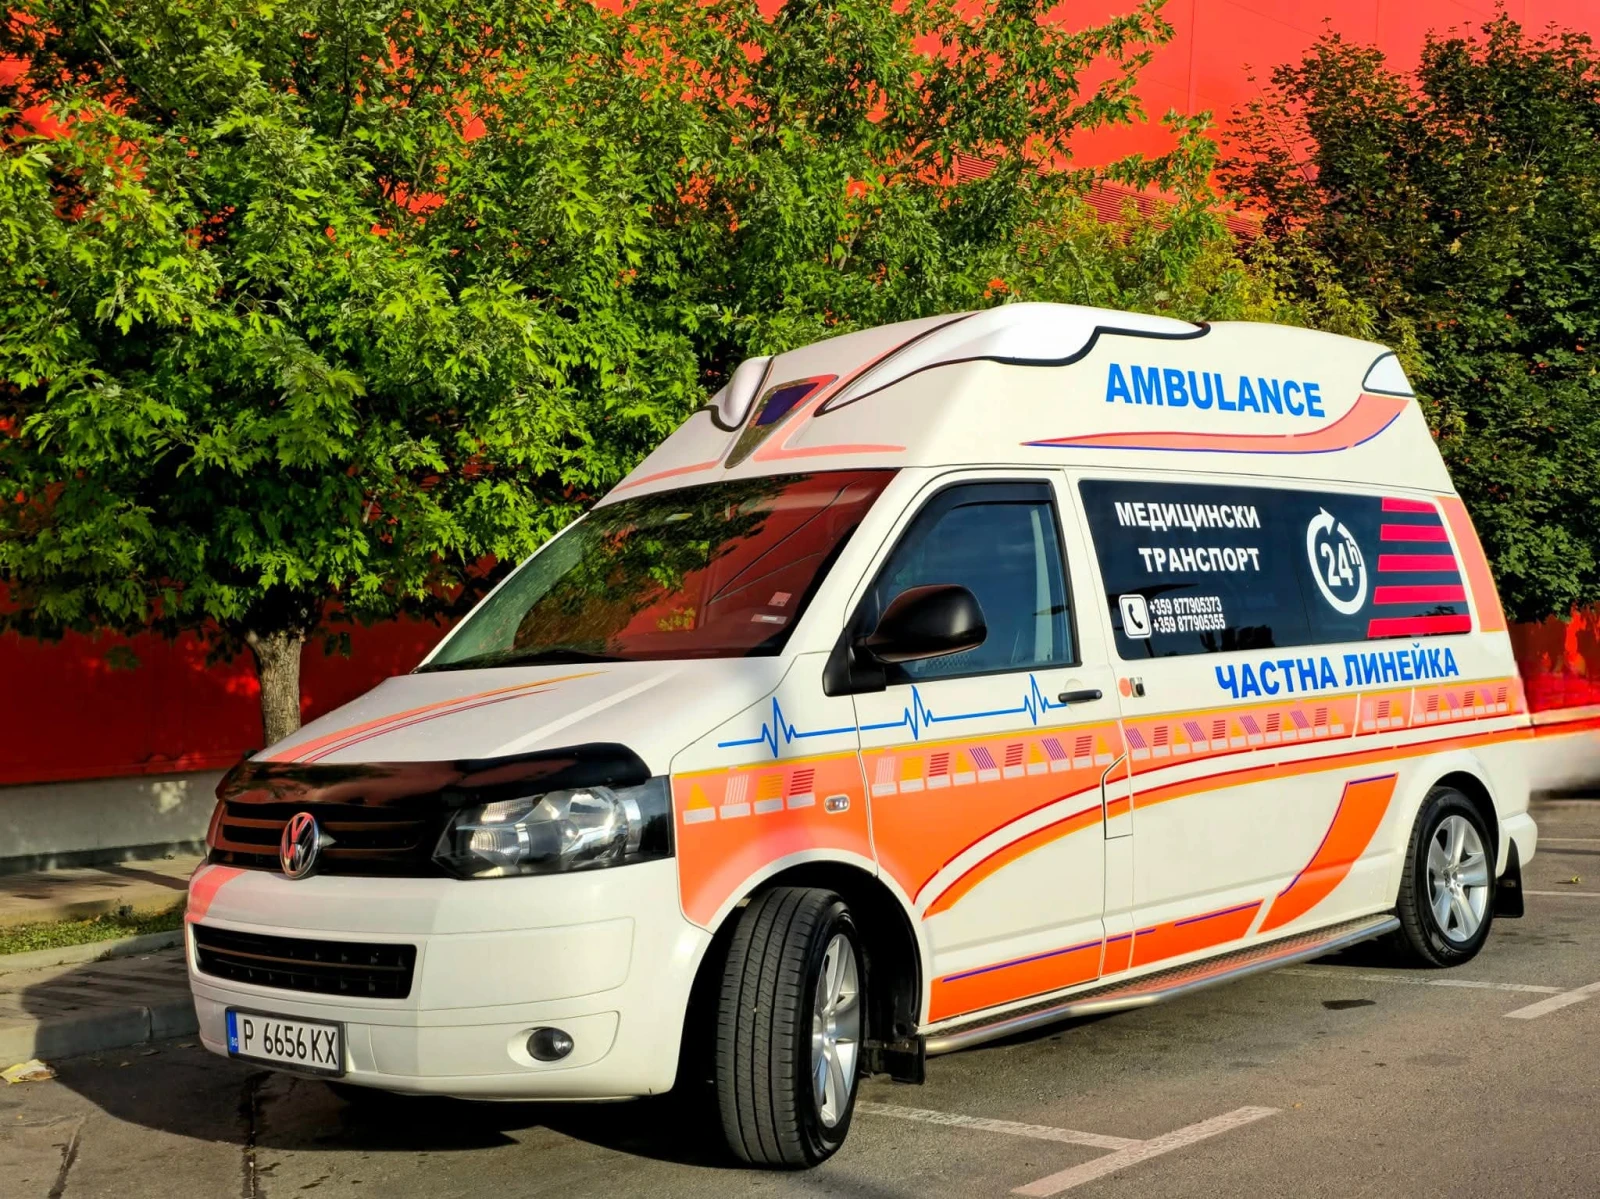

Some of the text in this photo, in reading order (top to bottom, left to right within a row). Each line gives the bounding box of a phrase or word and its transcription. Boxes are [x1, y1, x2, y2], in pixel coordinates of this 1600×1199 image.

[1105, 362, 1326, 418] AMBULANCE
[1114, 501, 1261, 532] МЕДИЦИНСКИ
[1138, 547, 1261, 573] ТРАНСПОРТ
[1150, 596, 1223, 616] +359 877905373
[1153, 613, 1226, 634] +359 877905355
[1215, 643, 1460, 699] ЧАСТНА ЛИНЕЙКА
[243, 1018, 255, 1051] P
